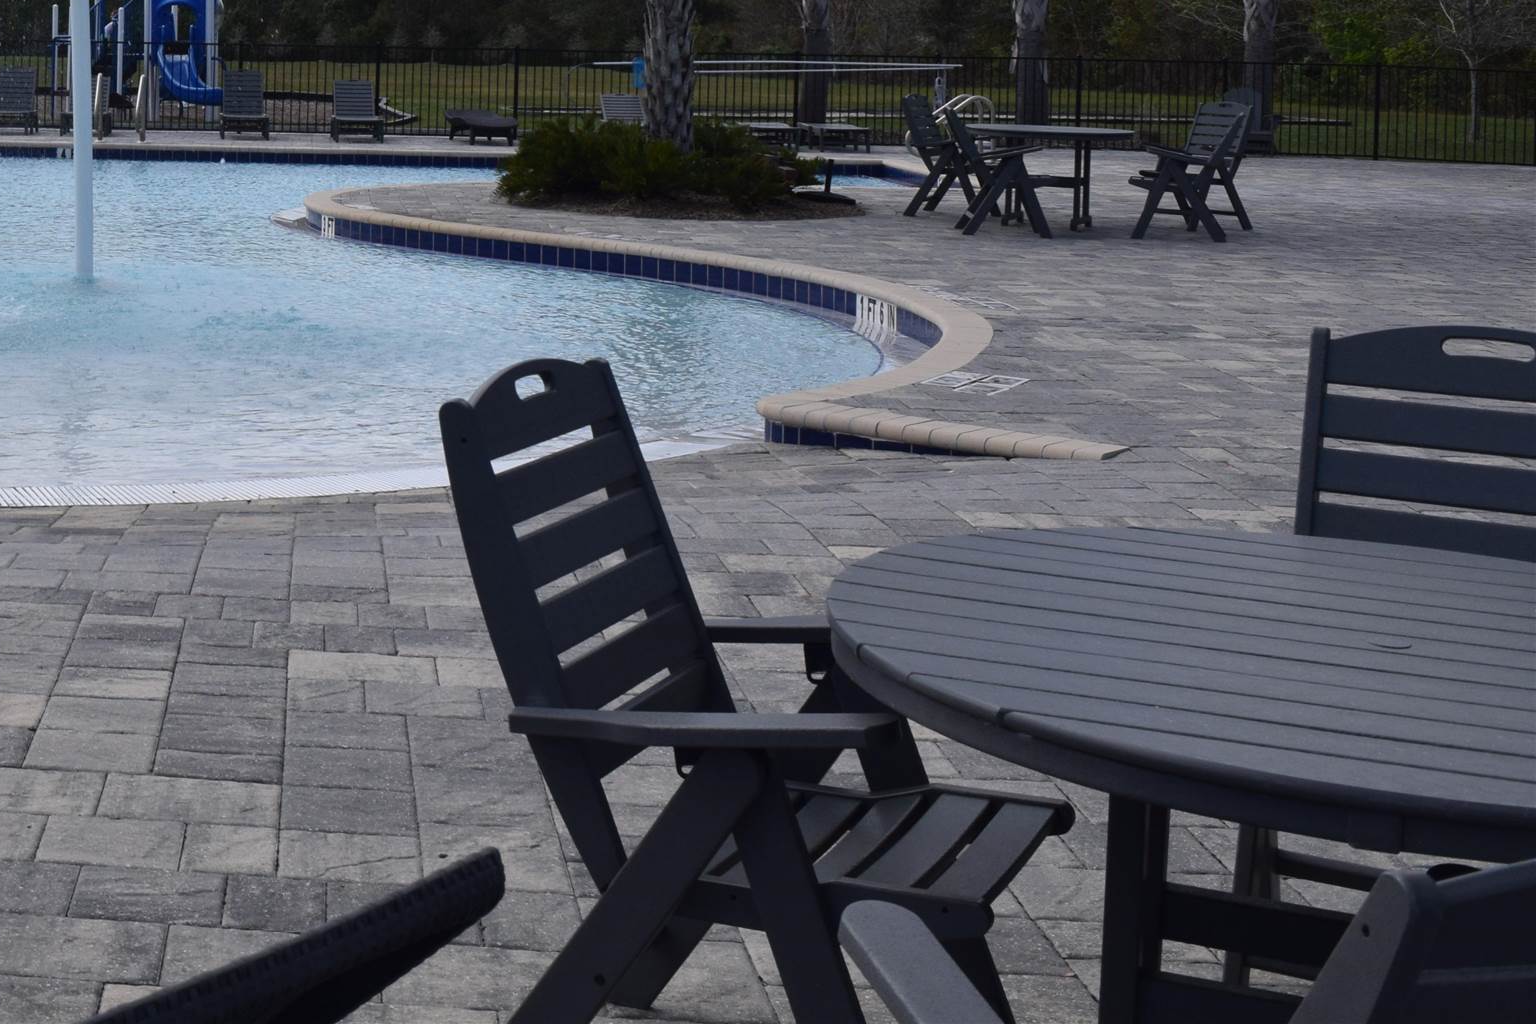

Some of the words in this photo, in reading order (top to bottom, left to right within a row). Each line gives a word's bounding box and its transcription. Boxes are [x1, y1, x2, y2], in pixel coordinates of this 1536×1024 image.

[867, 297, 877, 322] FT
[879, 301, 885, 325] 6
[887, 303, 895, 329] IN
